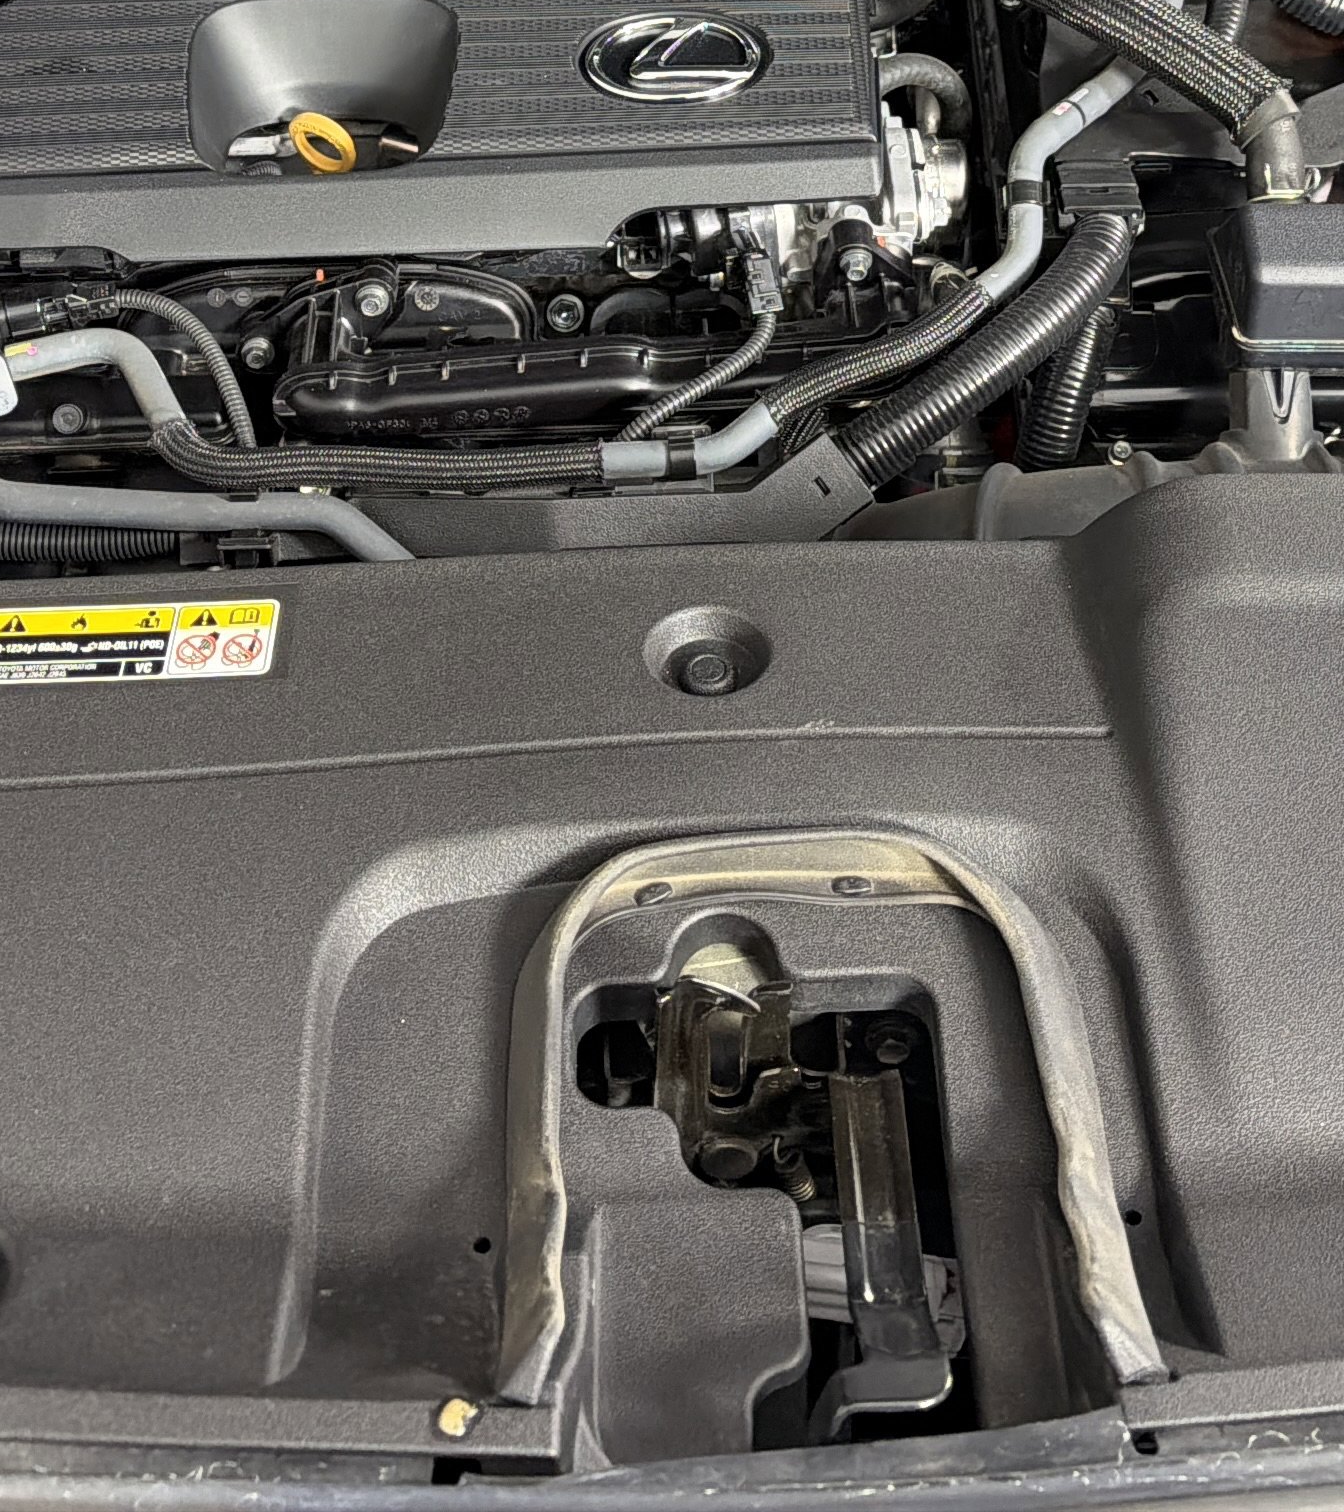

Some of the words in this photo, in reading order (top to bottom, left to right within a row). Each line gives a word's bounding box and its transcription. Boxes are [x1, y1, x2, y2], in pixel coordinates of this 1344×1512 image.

[139, 639, 165, 651] (POE)
[49, 663, 97, 671] CORPORATION
[134, 662, 154, 674] VC
